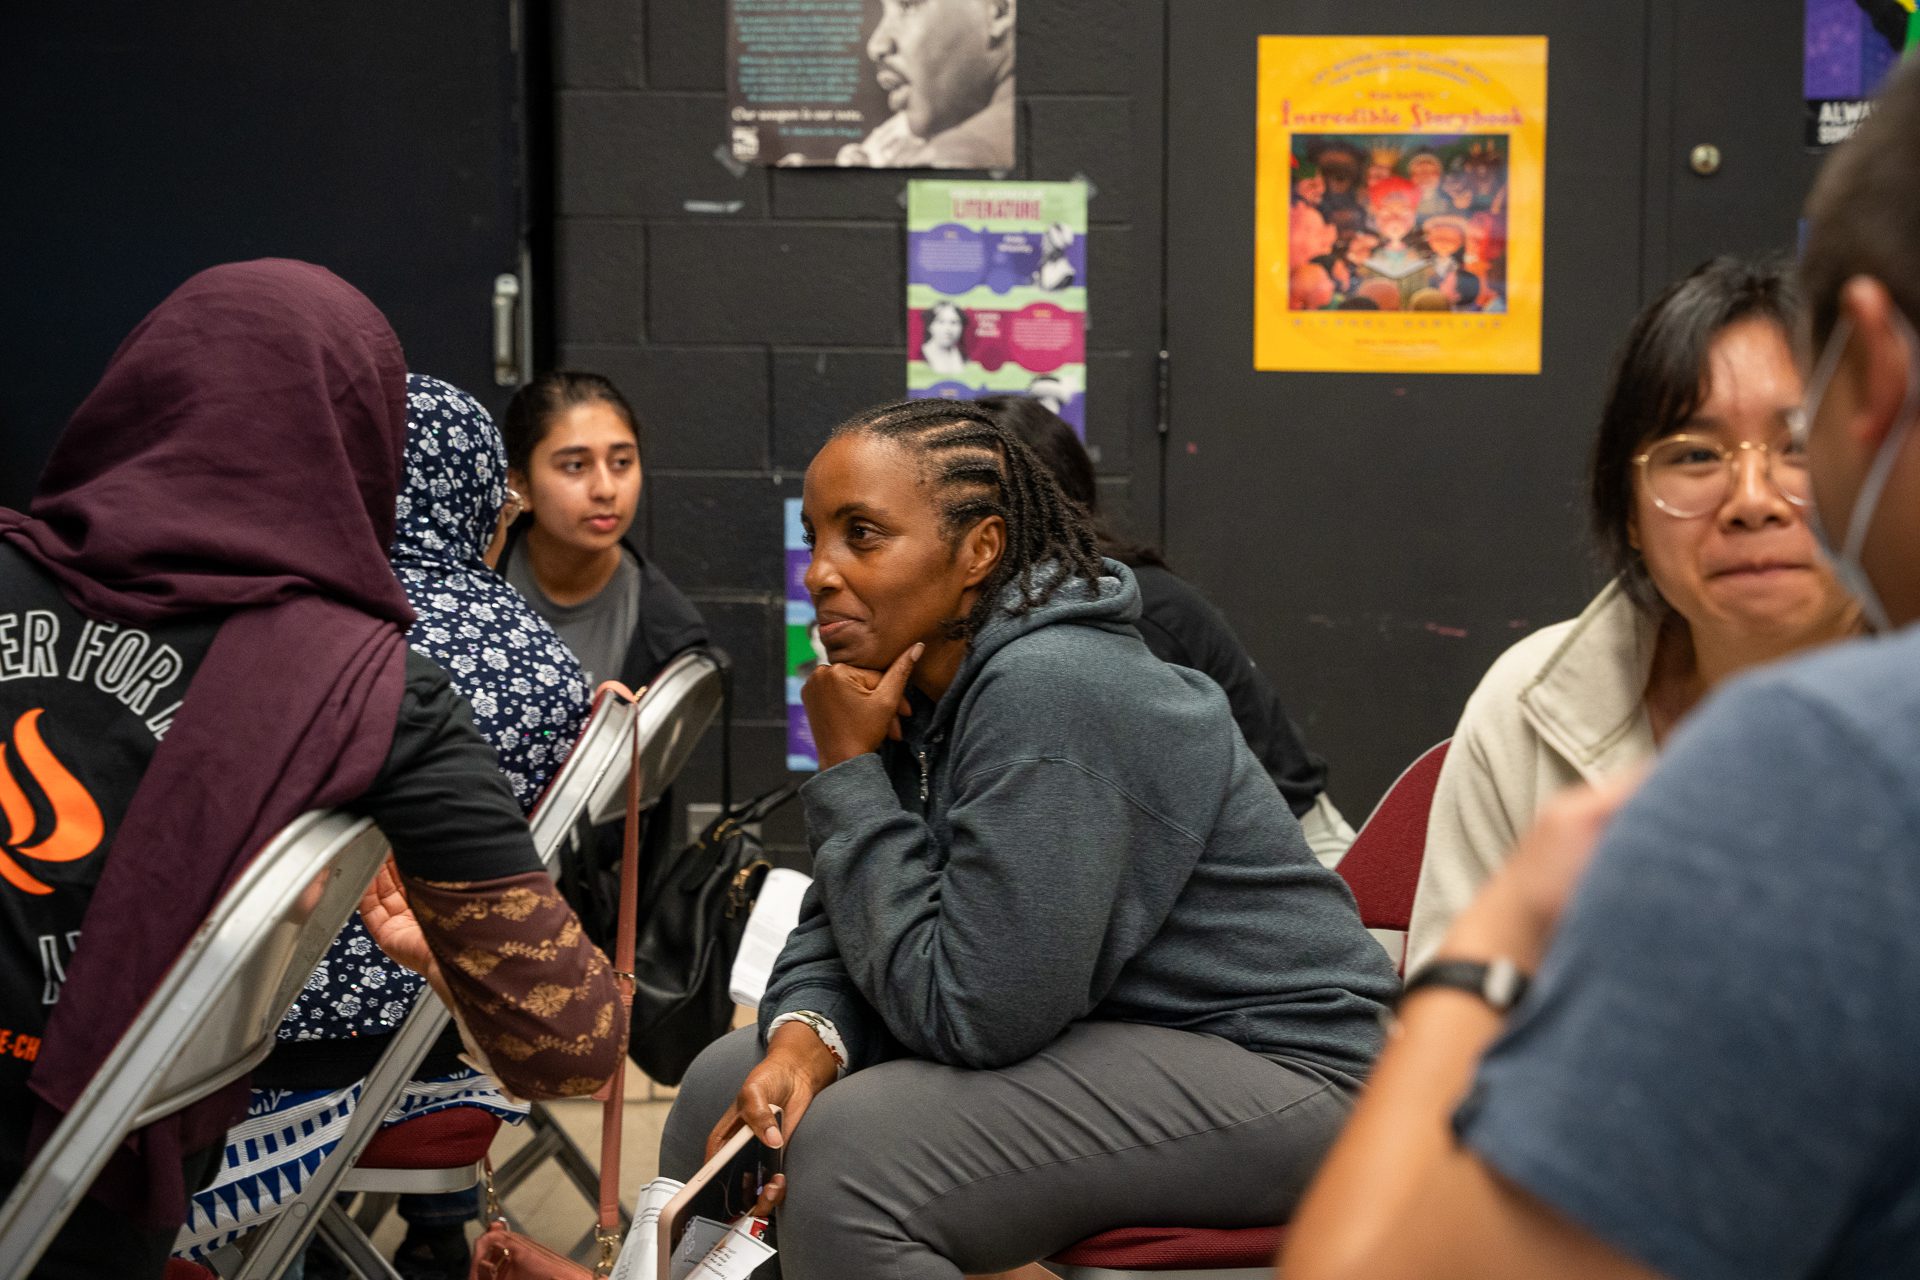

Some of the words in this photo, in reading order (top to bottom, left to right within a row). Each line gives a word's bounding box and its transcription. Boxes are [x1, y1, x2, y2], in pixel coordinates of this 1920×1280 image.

[1281, 99, 1399, 126] Incredible
[952, 199, 1040, 221] LITERATURE
[67, 619, 183, 716] FOR
